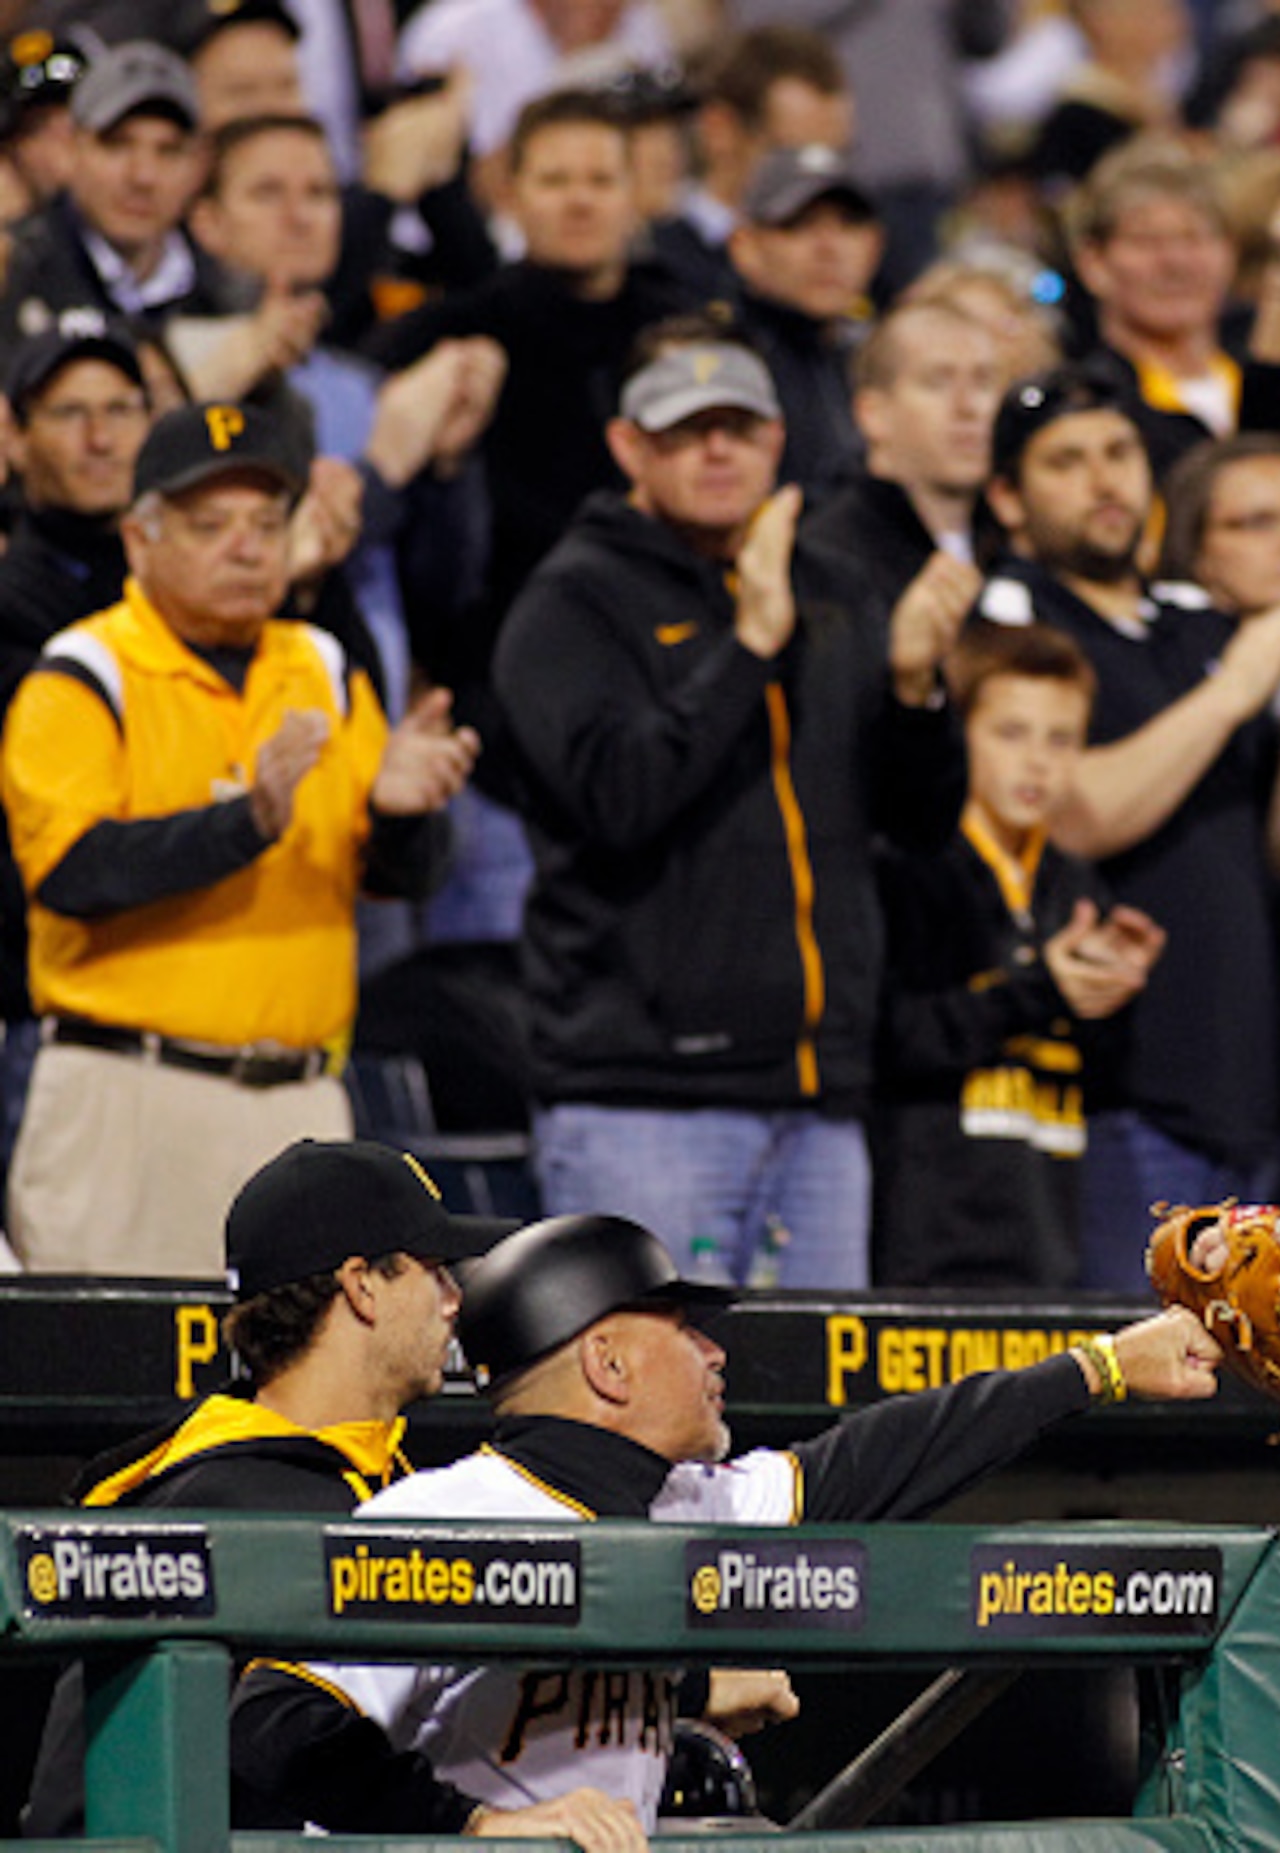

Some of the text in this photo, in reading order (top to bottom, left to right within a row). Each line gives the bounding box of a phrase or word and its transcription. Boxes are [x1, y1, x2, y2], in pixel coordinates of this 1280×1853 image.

[205, 406, 246, 451] P
[175, 1304, 218, 1399] P
[826, 1315, 868, 1406] P
[877, 1328, 947, 1392] GET
[28, 1540, 206, 1602] @Pirates
[332, 1545, 576, 1613] pirates.com
[693, 1552, 859, 1613] @Pirates
[976, 1562, 1214, 1627] pirates.com
[500, 1670, 676, 1766] PIRA
